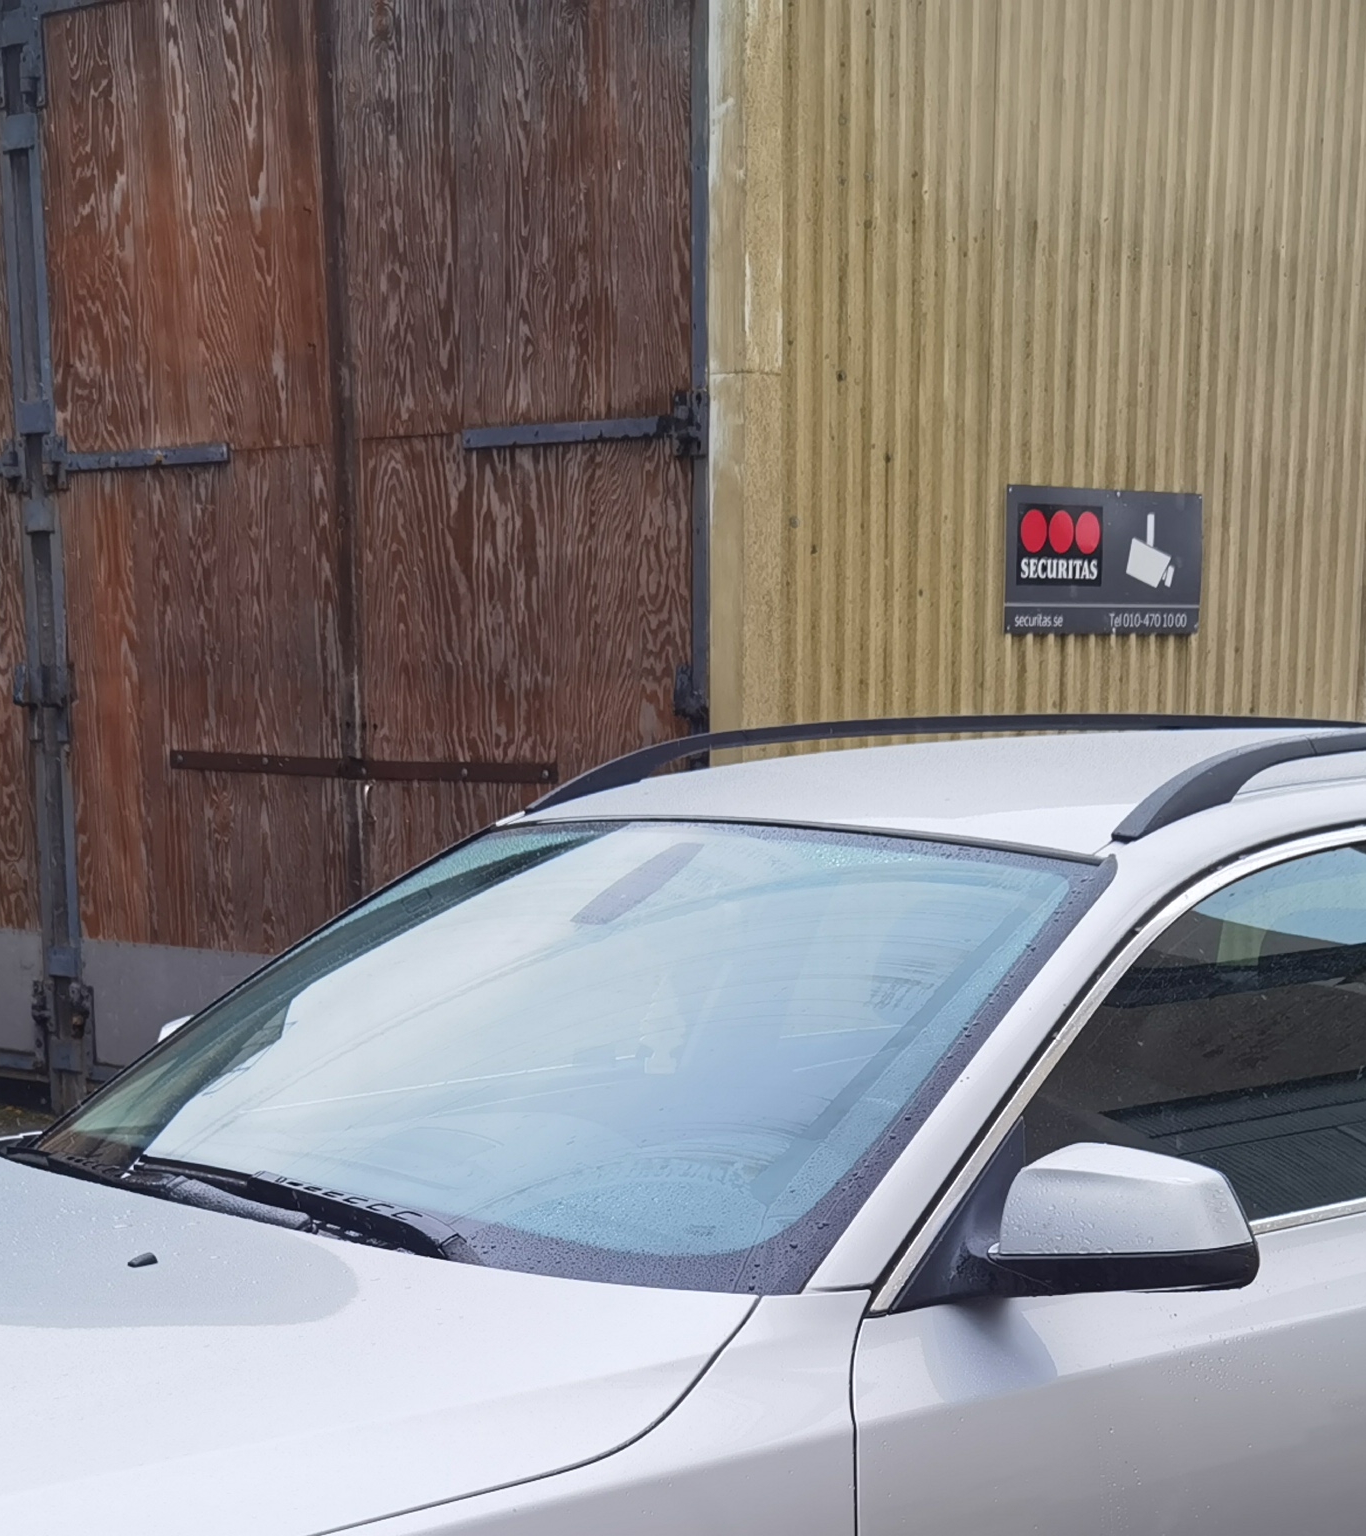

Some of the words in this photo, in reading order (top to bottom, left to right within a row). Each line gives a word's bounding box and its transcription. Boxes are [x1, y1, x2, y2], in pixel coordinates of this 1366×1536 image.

[1020, 557, 1098, 580] SECURITAS
[1109, 612, 1122, 627] Tel
[1123, 612, 1161, 628] 010-470
[1162, 612, 1174, 628] 10
[1175, 613, 1187, 628] 00
